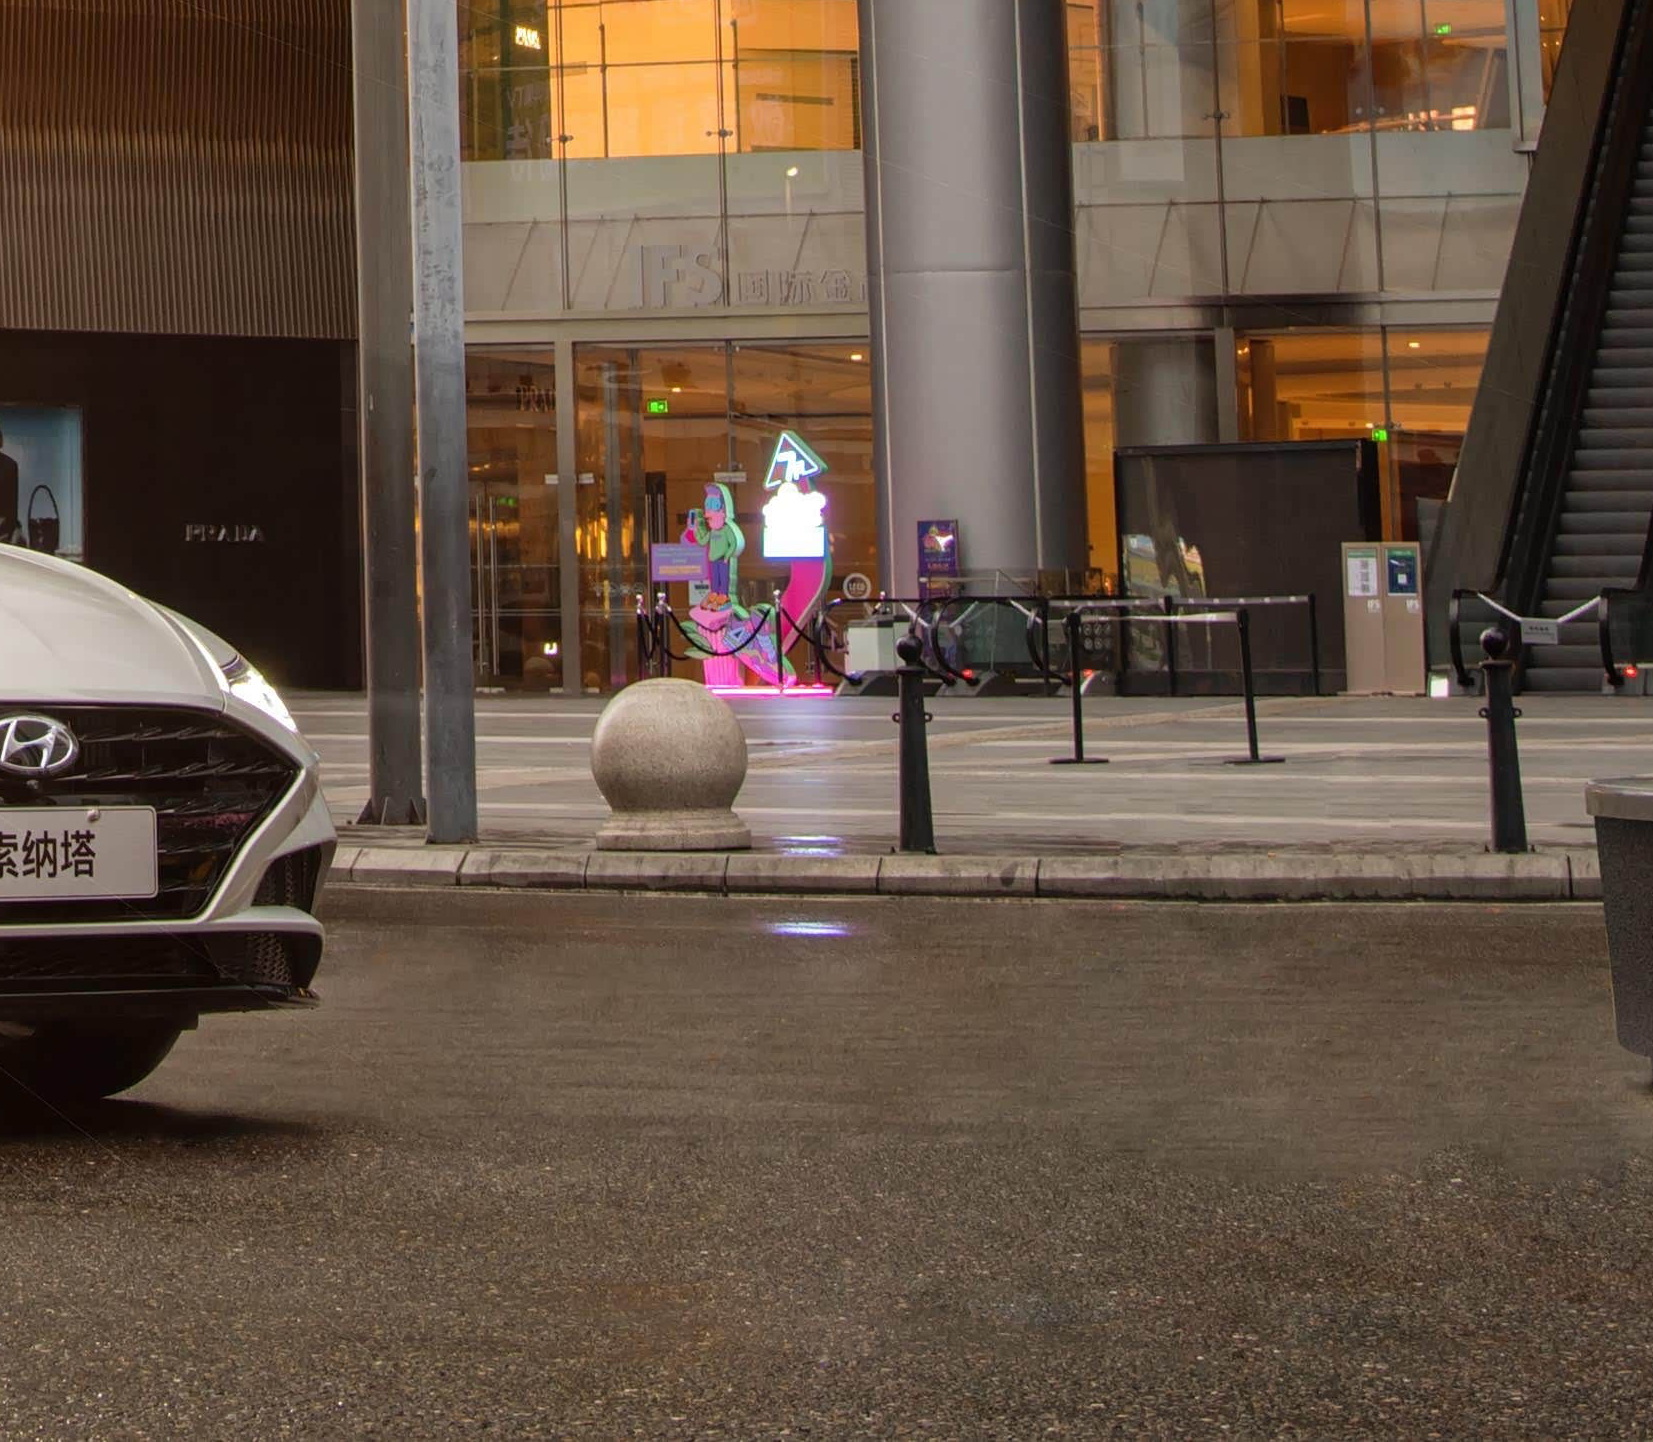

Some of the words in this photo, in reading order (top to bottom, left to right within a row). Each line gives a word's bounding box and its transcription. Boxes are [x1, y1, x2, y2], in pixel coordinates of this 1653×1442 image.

[627, 244, 725, 309] IFS
[734, 270, 869, 307] 国际金
[185, 523, 266, 542] PRADA
